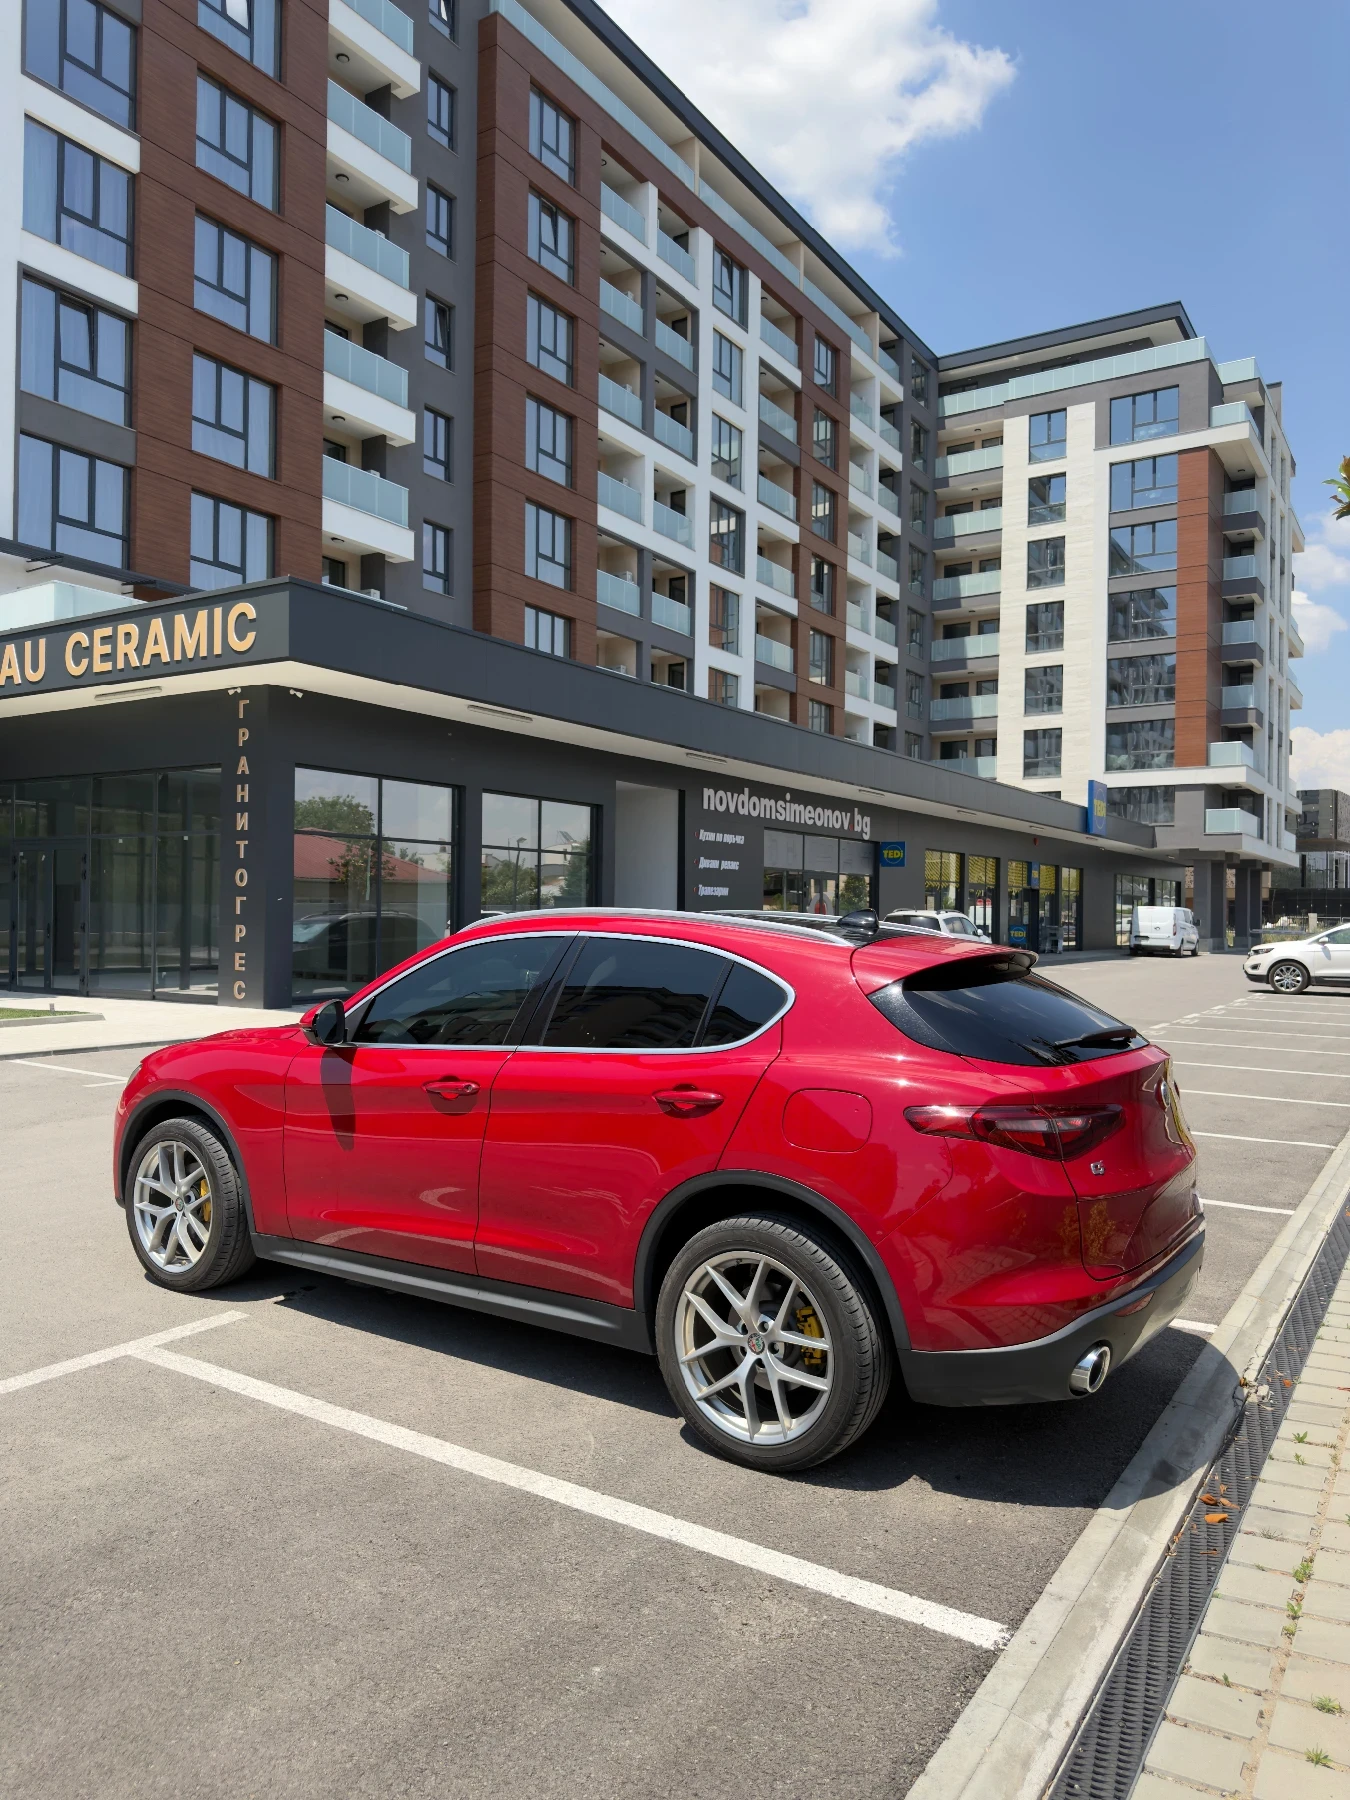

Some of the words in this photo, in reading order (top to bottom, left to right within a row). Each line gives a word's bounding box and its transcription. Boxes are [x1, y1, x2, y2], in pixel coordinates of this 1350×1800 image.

[0, 638, 46, 686] AU
[65, 602, 257, 677] CERAMIC
[702, 787, 871, 840] novdomsimeonov.bg
[233, 699, 250, 1001] ГРАНИТОГРЕС
[698, 856, 720, 869] Дивани
[720, 860, 740, 871] релакс
[883, 849, 904, 859] TEDi
